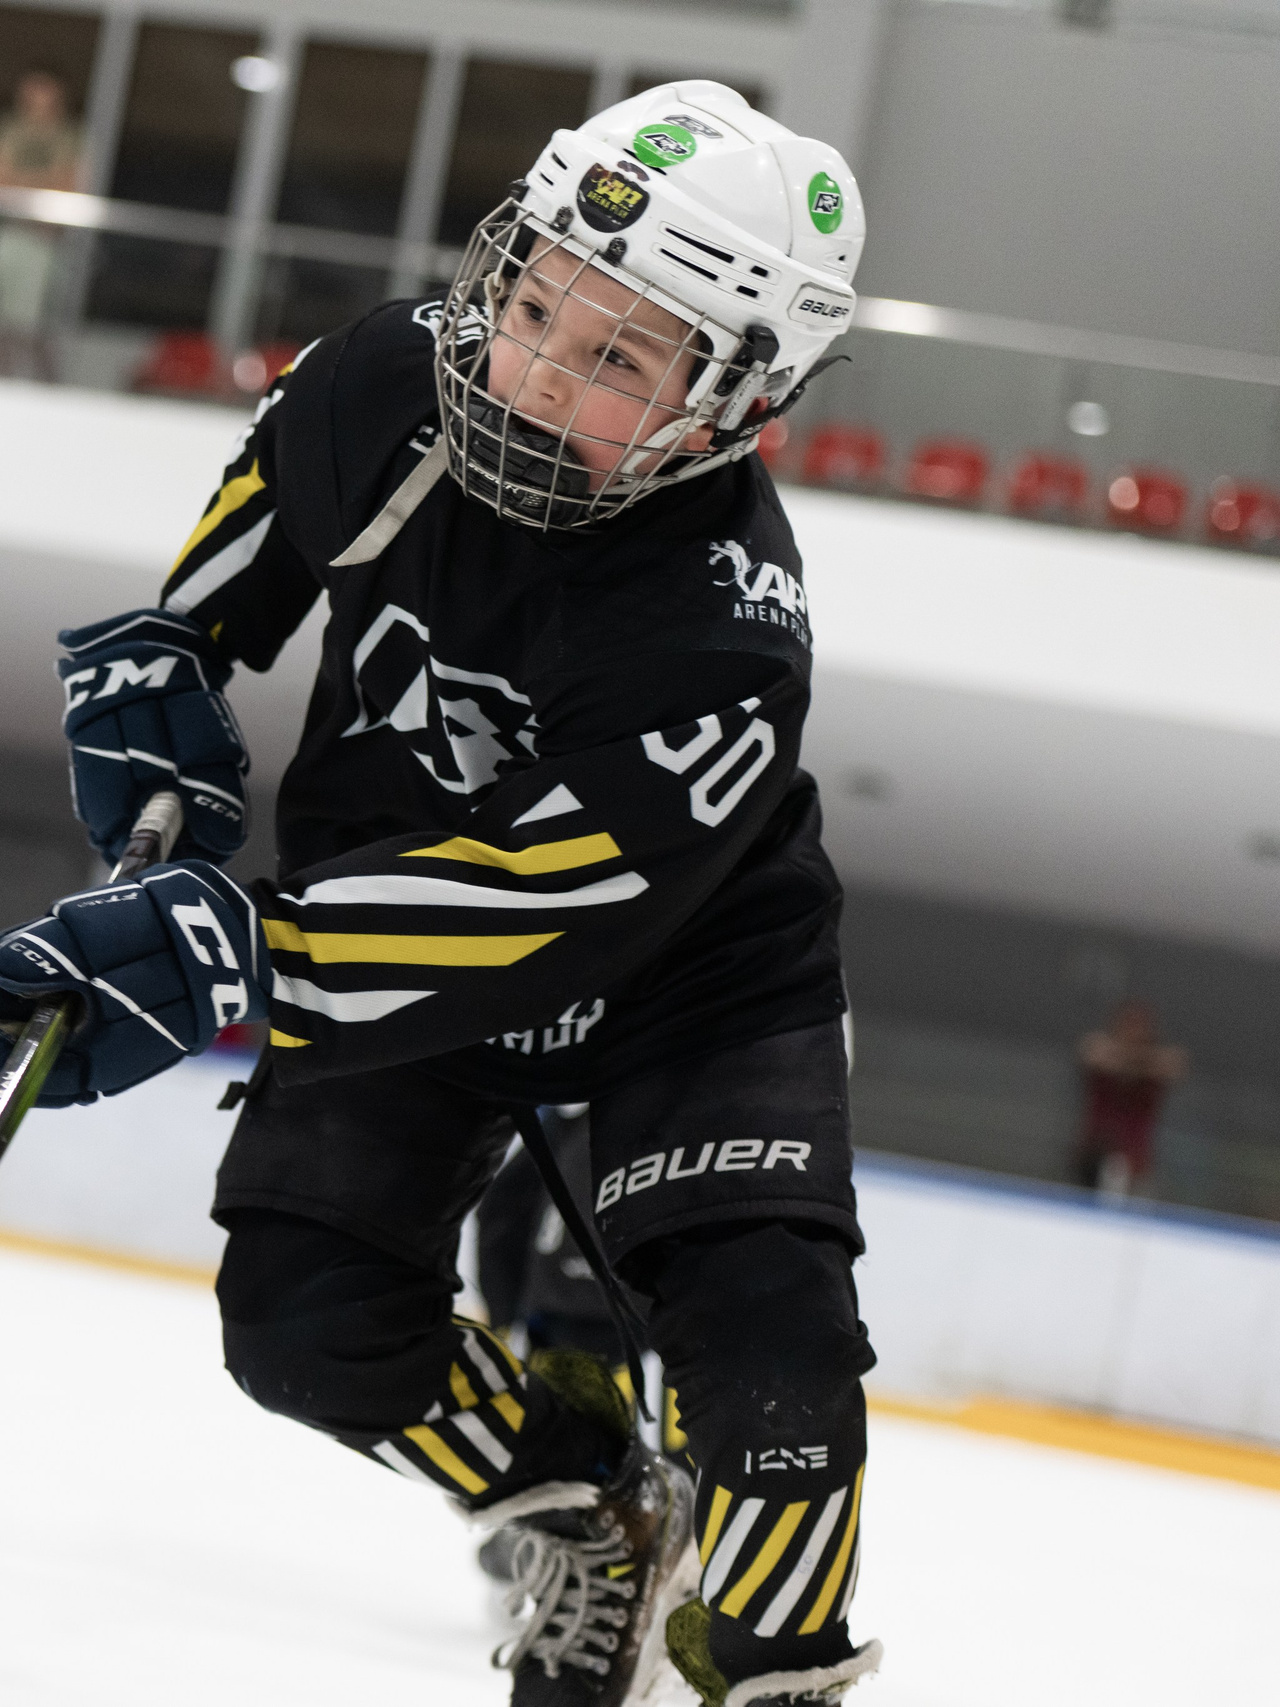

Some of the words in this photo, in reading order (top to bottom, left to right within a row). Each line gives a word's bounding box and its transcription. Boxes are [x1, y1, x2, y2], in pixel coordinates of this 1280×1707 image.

[798, 299, 849, 319] BAUER
[733, 602, 788, 628] ARENA
[193, 794, 241, 822] CCM
[10, 942, 60, 976] CCM
[594, 1138, 811, 1215] BAUER
